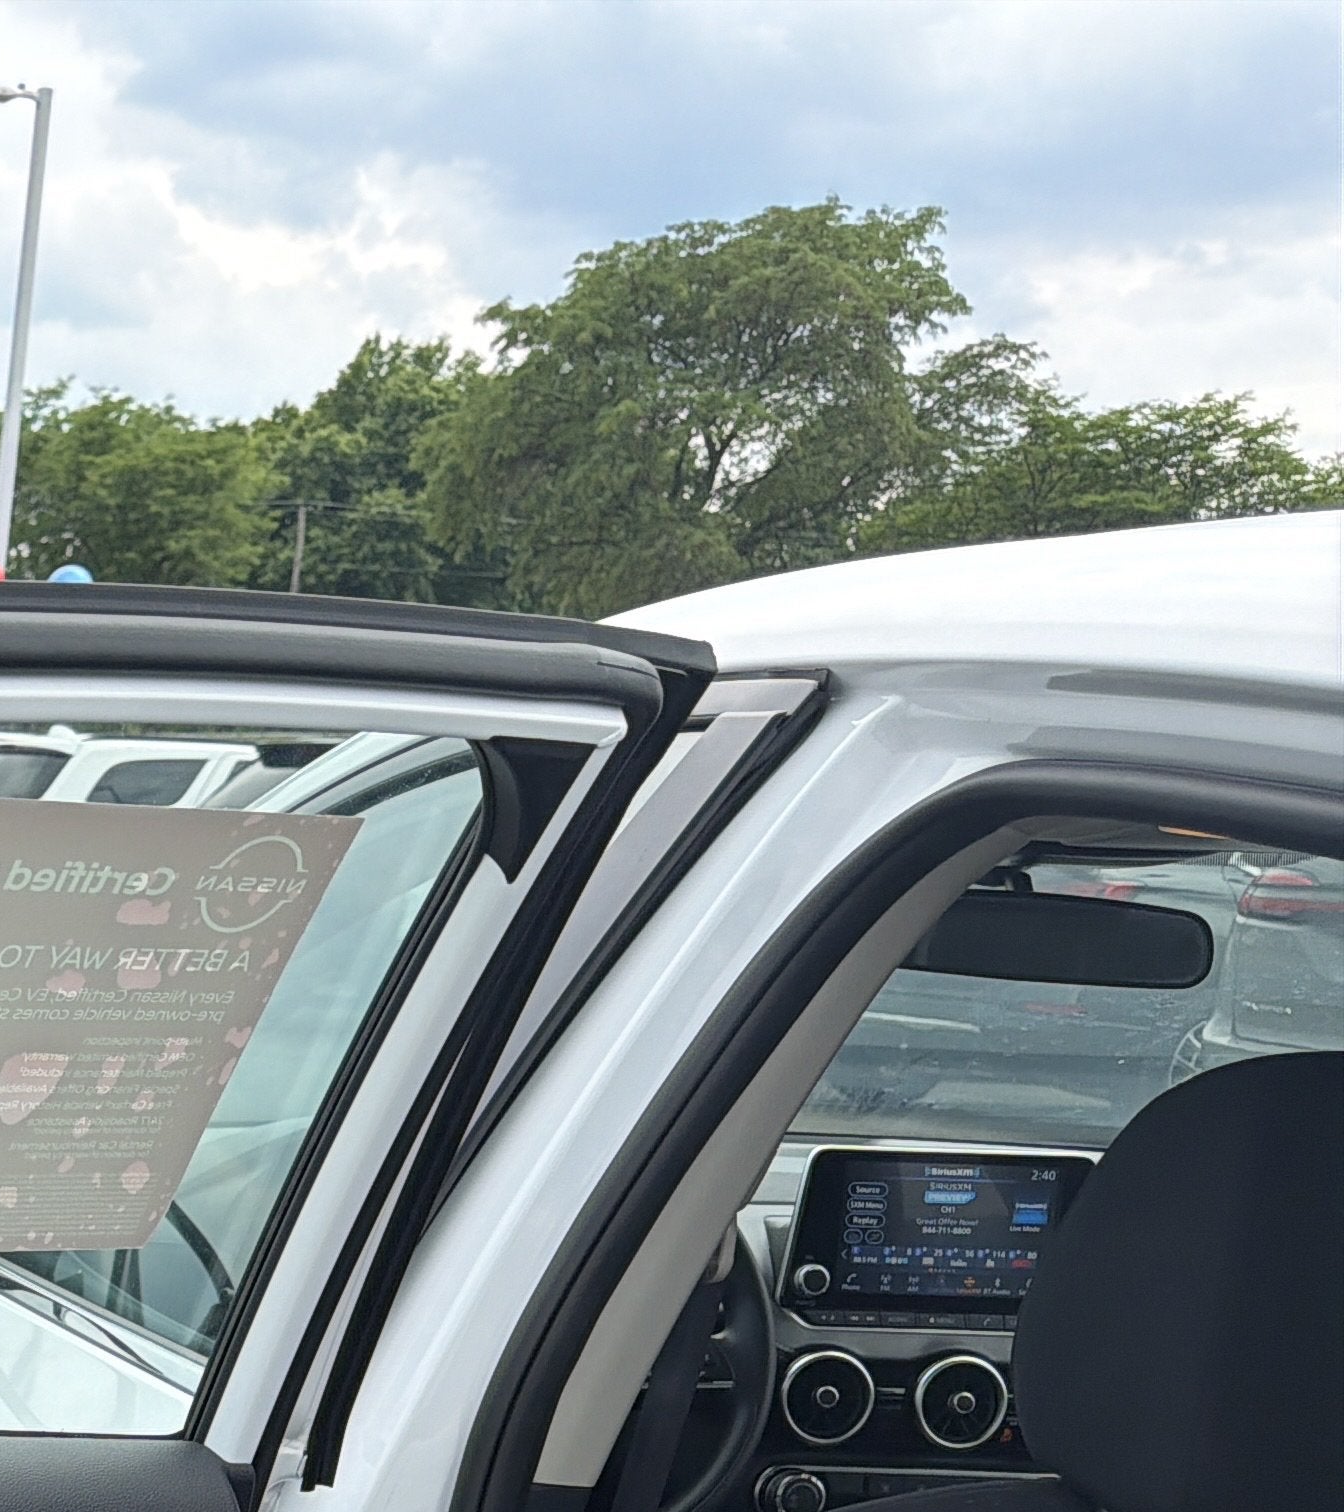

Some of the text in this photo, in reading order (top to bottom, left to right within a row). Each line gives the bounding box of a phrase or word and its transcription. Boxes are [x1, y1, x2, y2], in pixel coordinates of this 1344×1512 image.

[930, 1167, 974, 1177] SiriusXM
[1030, 1169, 1057, 1182] 2:40
[855, 1185, 882, 1195] Source
[850, 1200, 884, 1210] SXM Menu
[852, 1216, 879, 1226] Replay
[933, 1248, 944, 1257] 25
[841, 1283, 861, 1291] Phone
